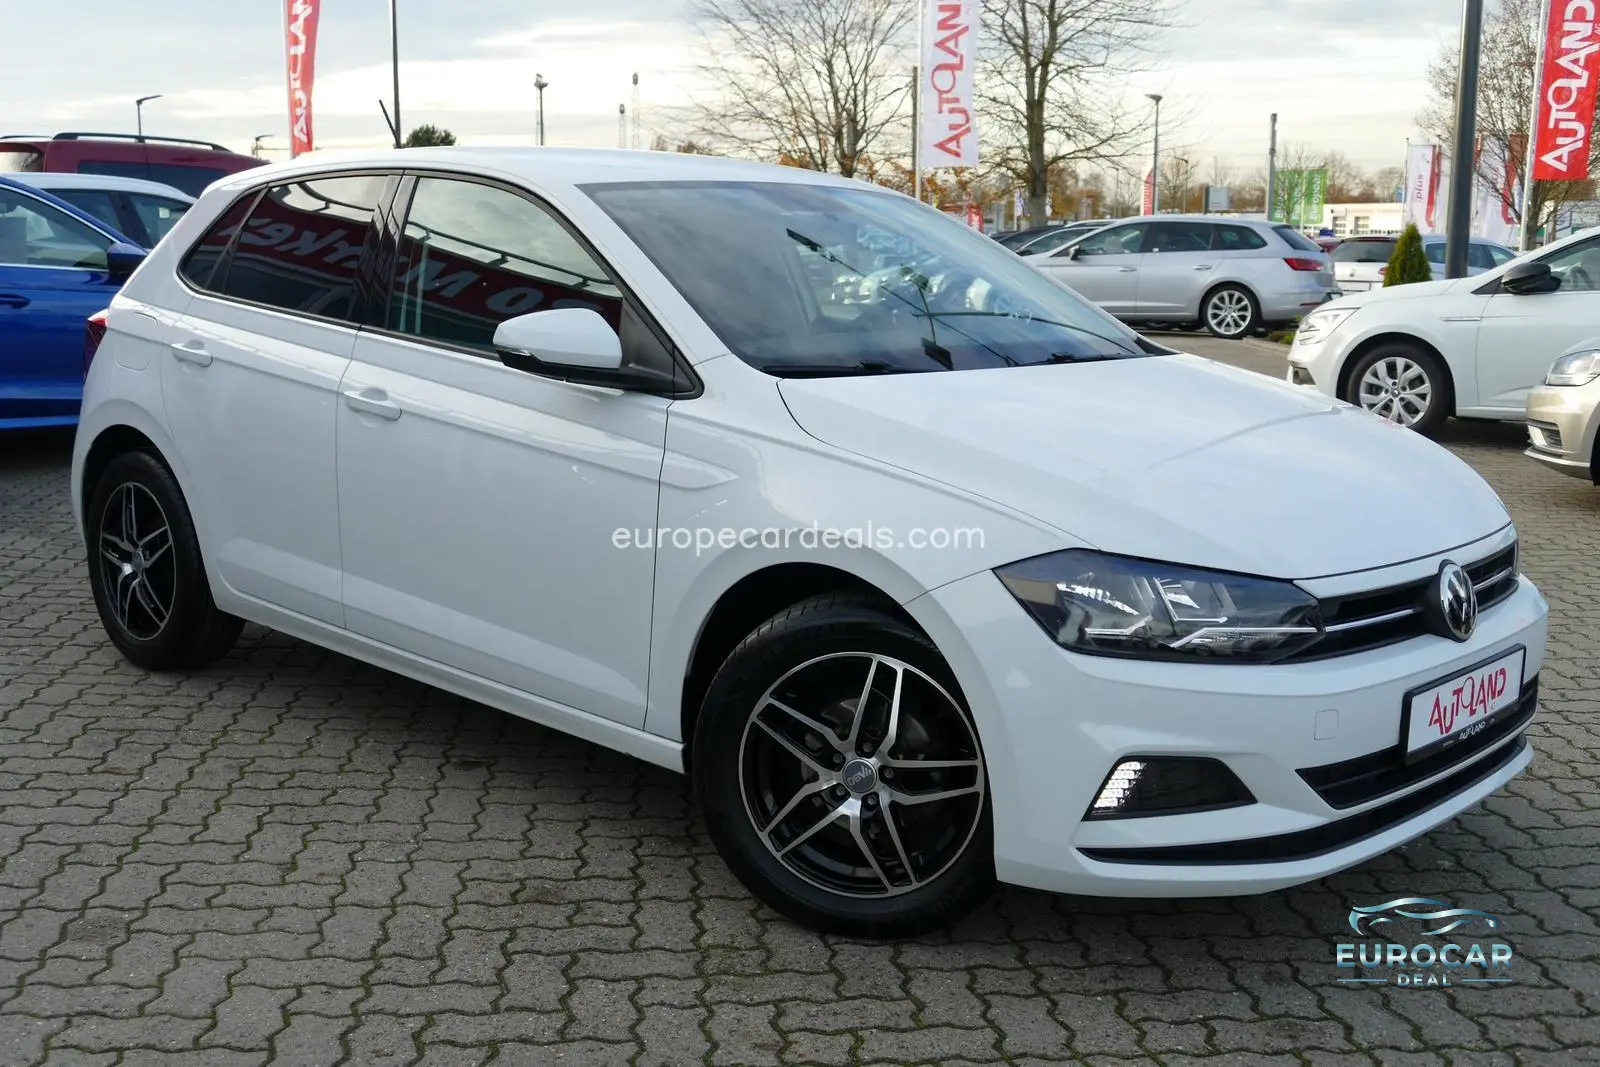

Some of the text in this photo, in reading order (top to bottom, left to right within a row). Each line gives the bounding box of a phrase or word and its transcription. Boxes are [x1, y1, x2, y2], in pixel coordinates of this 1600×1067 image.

[931, 0, 971, 158] AUTOLAN
[1539, 0, 1600, 172] AUTOLAND
[1428, 667, 1507, 735] AUTOLAND
